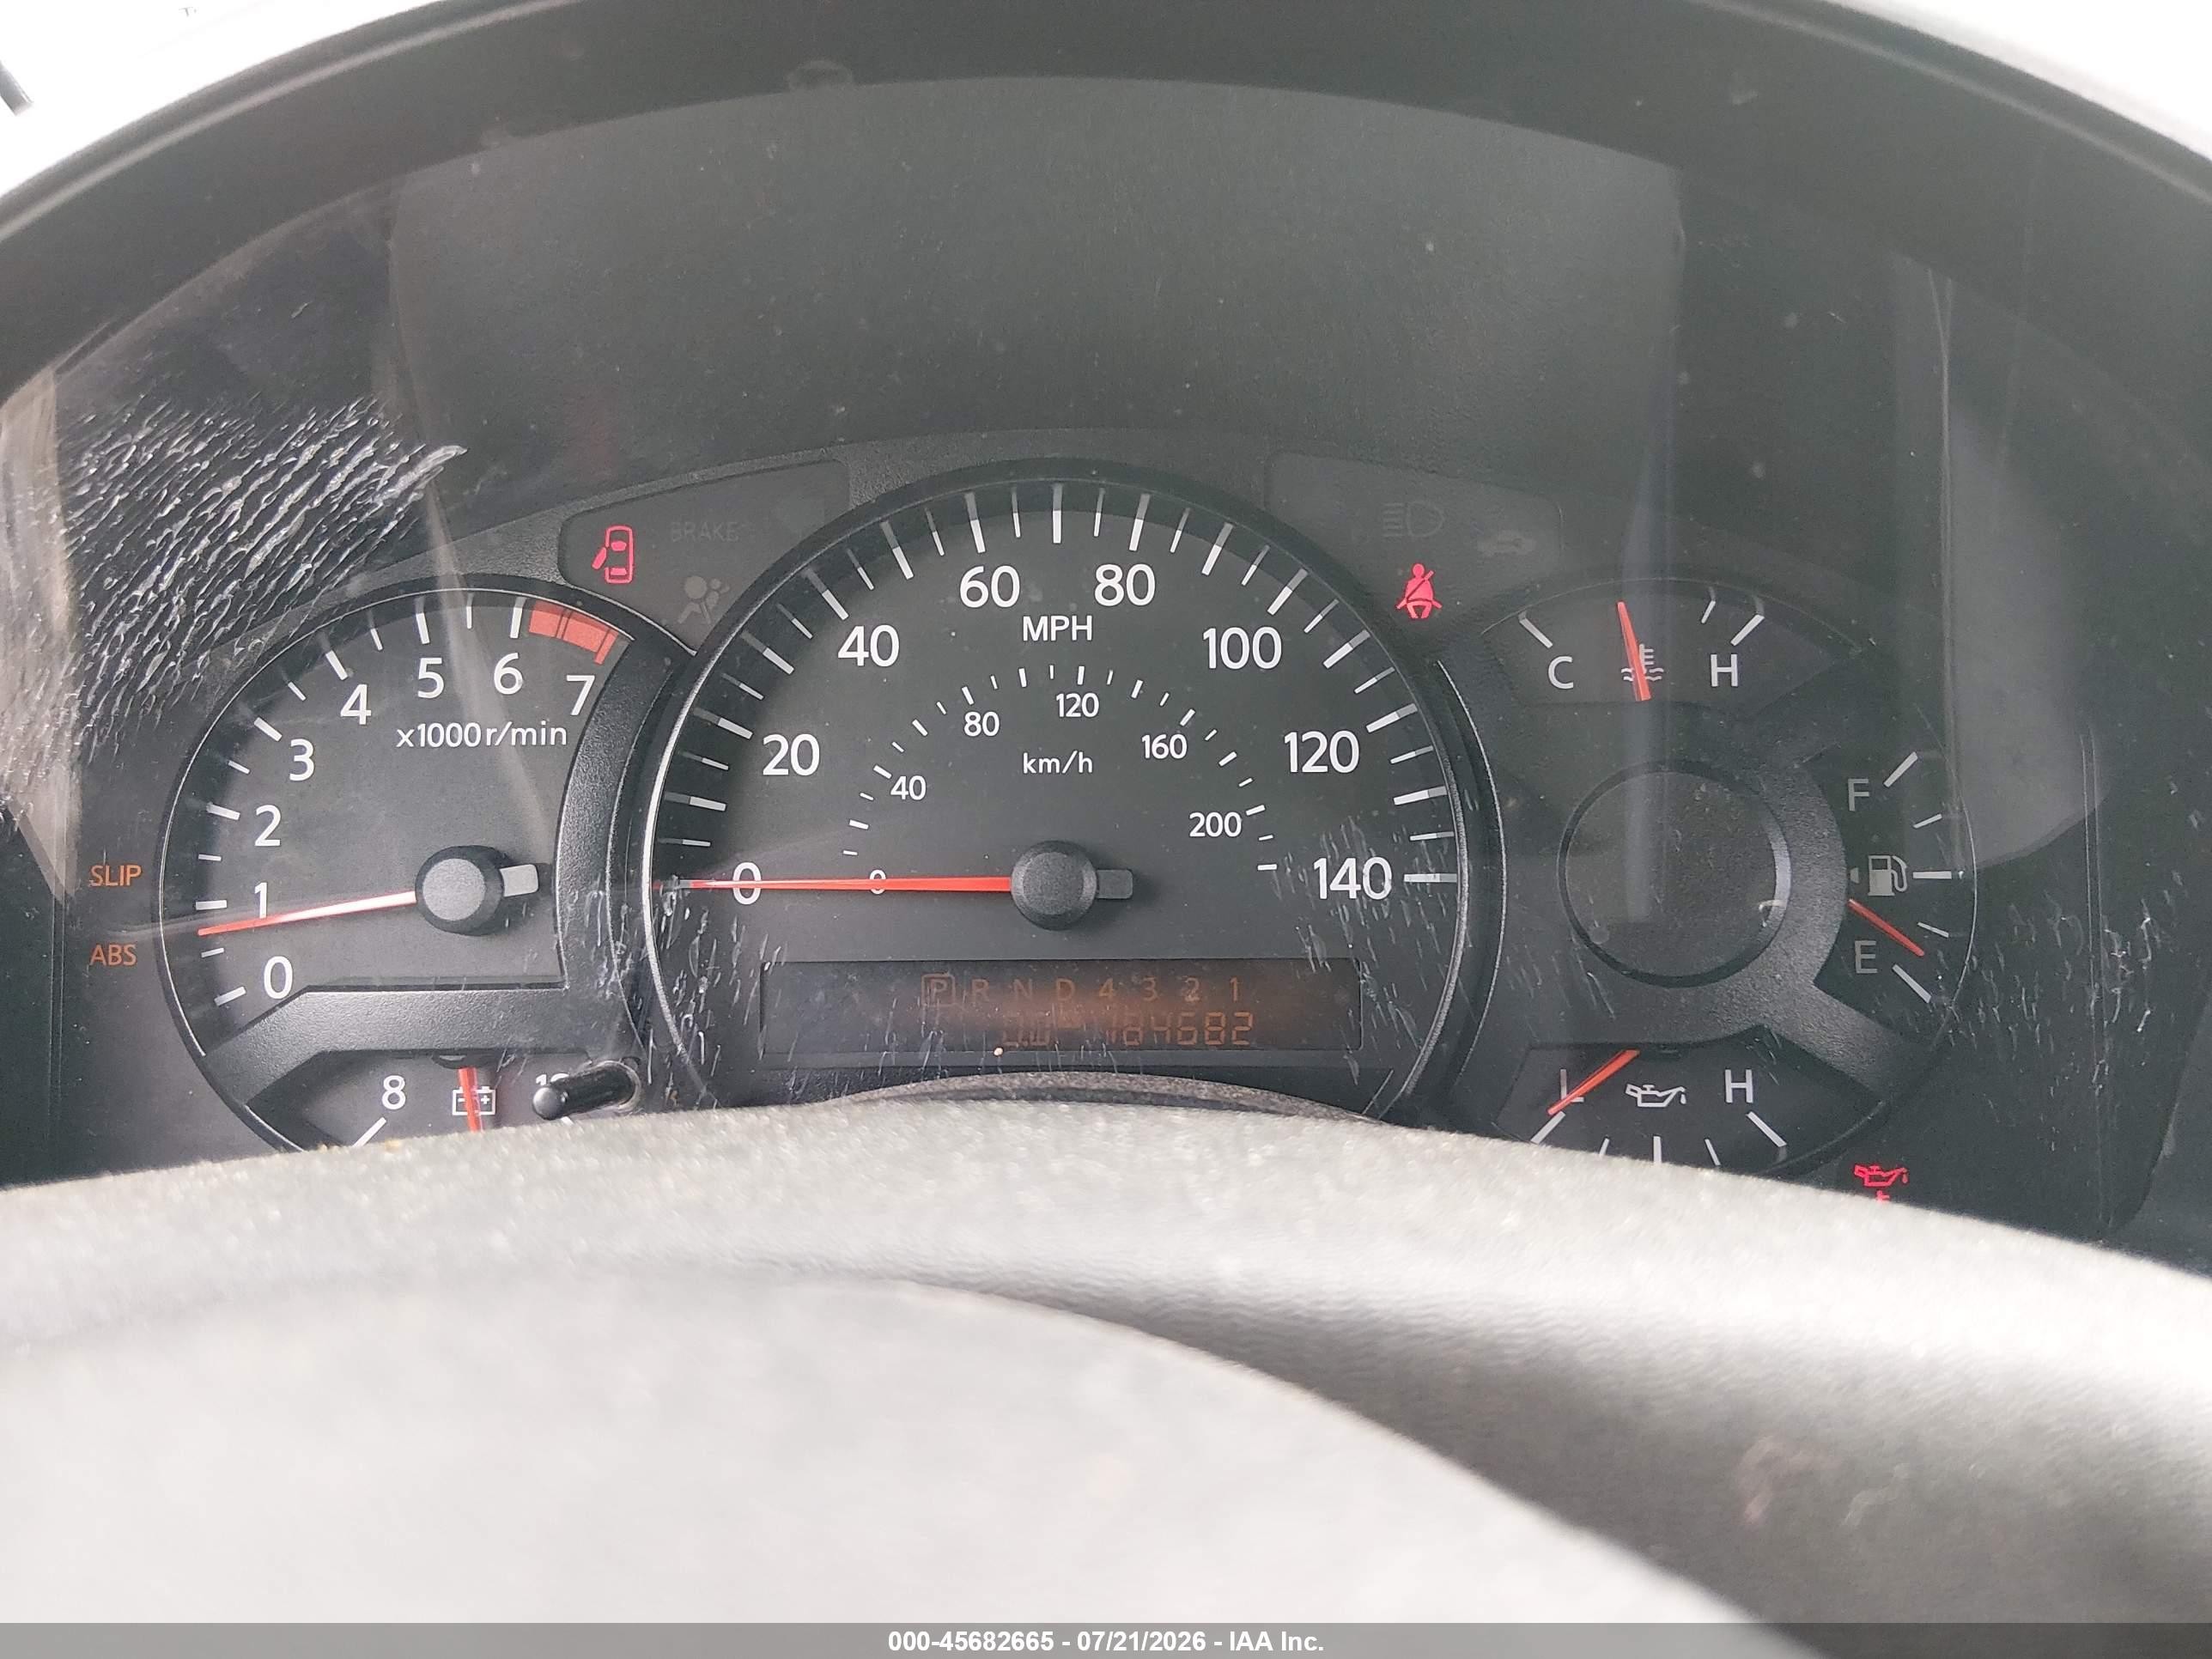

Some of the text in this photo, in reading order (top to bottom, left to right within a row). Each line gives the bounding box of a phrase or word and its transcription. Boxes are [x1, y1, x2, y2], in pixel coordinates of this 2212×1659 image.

[671, 522, 739, 542] BRAKE
[959, 566, 1020, 608] 60
[1095, 564, 1156, 606] 80
[1023, 615, 1092, 641] MPH
[837, 625, 900, 666] 40
[1203, 628, 1282, 669] 100
[417, 659, 443, 697] 5
[493, 654, 522, 695] 6
[1547, 656, 1574, 689] C
[1711, 654, 1738, 687] H
[340, 685, 371, 725] 4
[565, 675, 595, 716] 7
[1056, 693, 1099, 718] 120
[485, 722, 567, 748] r/min
[964, 712, 1000, 737] 80
[289, 740, 314, 781] 3
[763, 734, 820, 775] 20
[1023, 751, 1092, 774] km/h
[1142, 734, 1188, 759] 160
[1284, 732, 1358, 773] 120
[890, 776, 927, 800] 40
[1848, 779, 1869, 811] F
[254, 805, 281, 846] 2
[1188, 812, 1242, 837] 200
[89, 865, 141, 887] SLIP
[732, 862, 762, 905] 0
[869, 870, 886, 895] 0
[1314, 858, 1392, 900] 140
[254, 883, 268, 919] 1
[90, 944, 137, 965] ABS
[1855, 941, 1876, 973] E
[264, 957, 294, 998] 0
[930, 977, 1239, 1002] P R N D 4 3 2 1
[383, 1076, 405, 1110] 8
[1561, 1069, 1583, 1103] L
[1726, 1070, 1753, 1103] H
